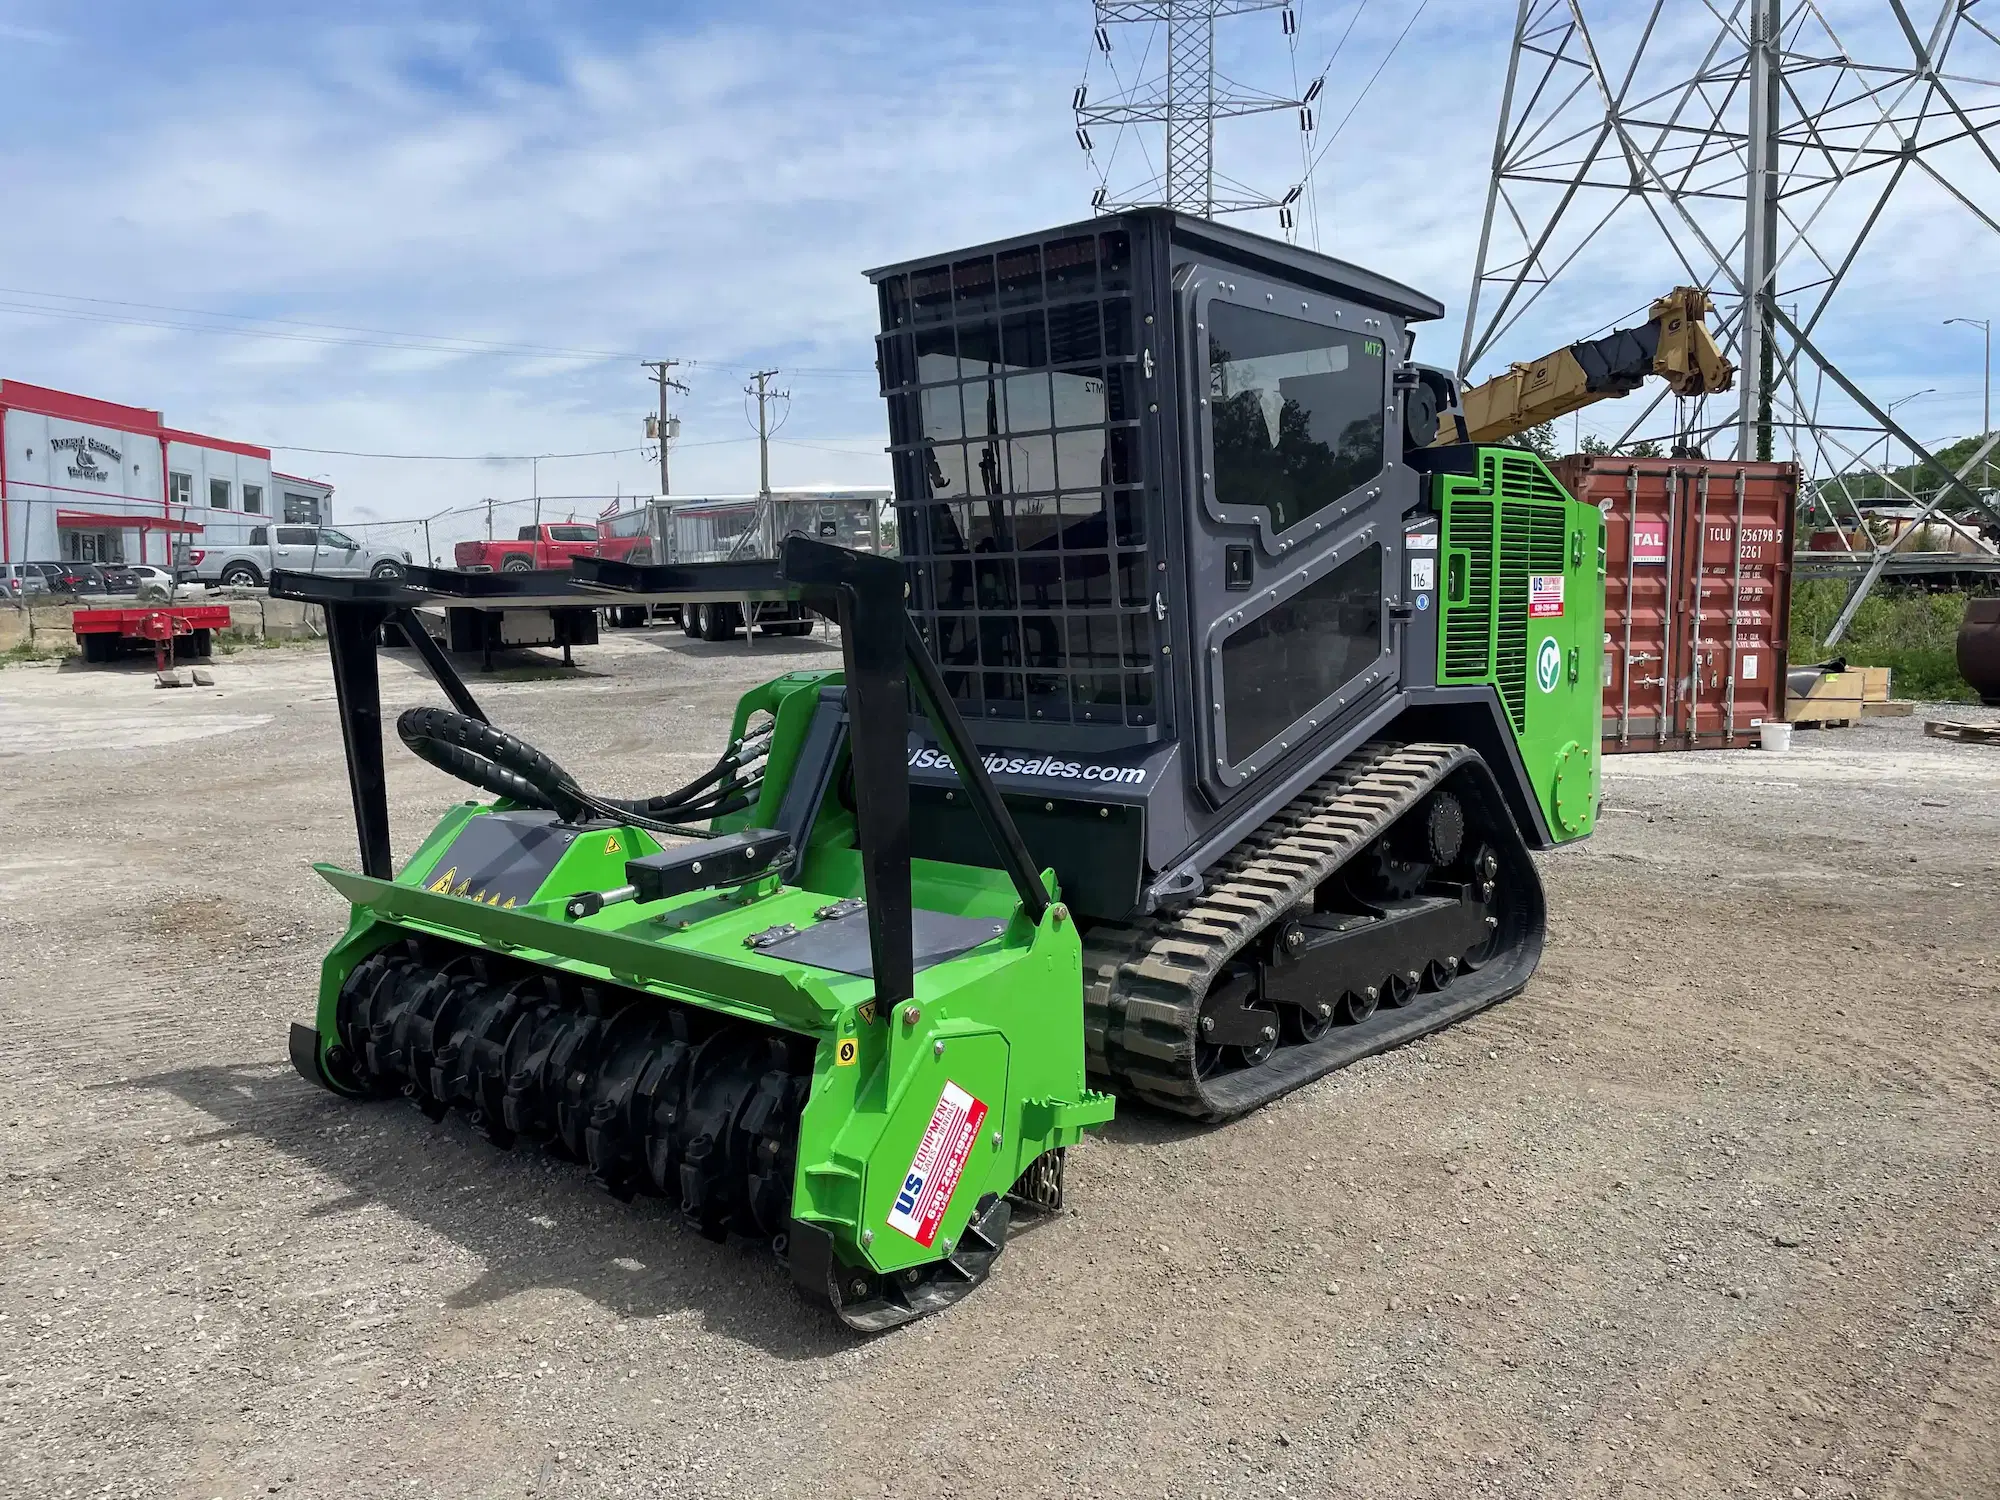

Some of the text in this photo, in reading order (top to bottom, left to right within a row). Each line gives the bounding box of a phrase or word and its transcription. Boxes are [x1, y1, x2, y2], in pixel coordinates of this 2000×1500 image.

[1364, 341, 1382, 357] MT2
[1633, 533, 1664, 546] TAL
[1710, 527, 1783, 543] TCLU 256798 5
[1741, 545, 1762, 558] 22G1
[1413, 573, 1425, 587] 116
[1533, 577, 1543, 591] US
[914, 1096, 950, 1170] EQUIPMENT
[922, 1148, 937, 1174] SALES
[939, 1101, 957, 1136] RENTALS
